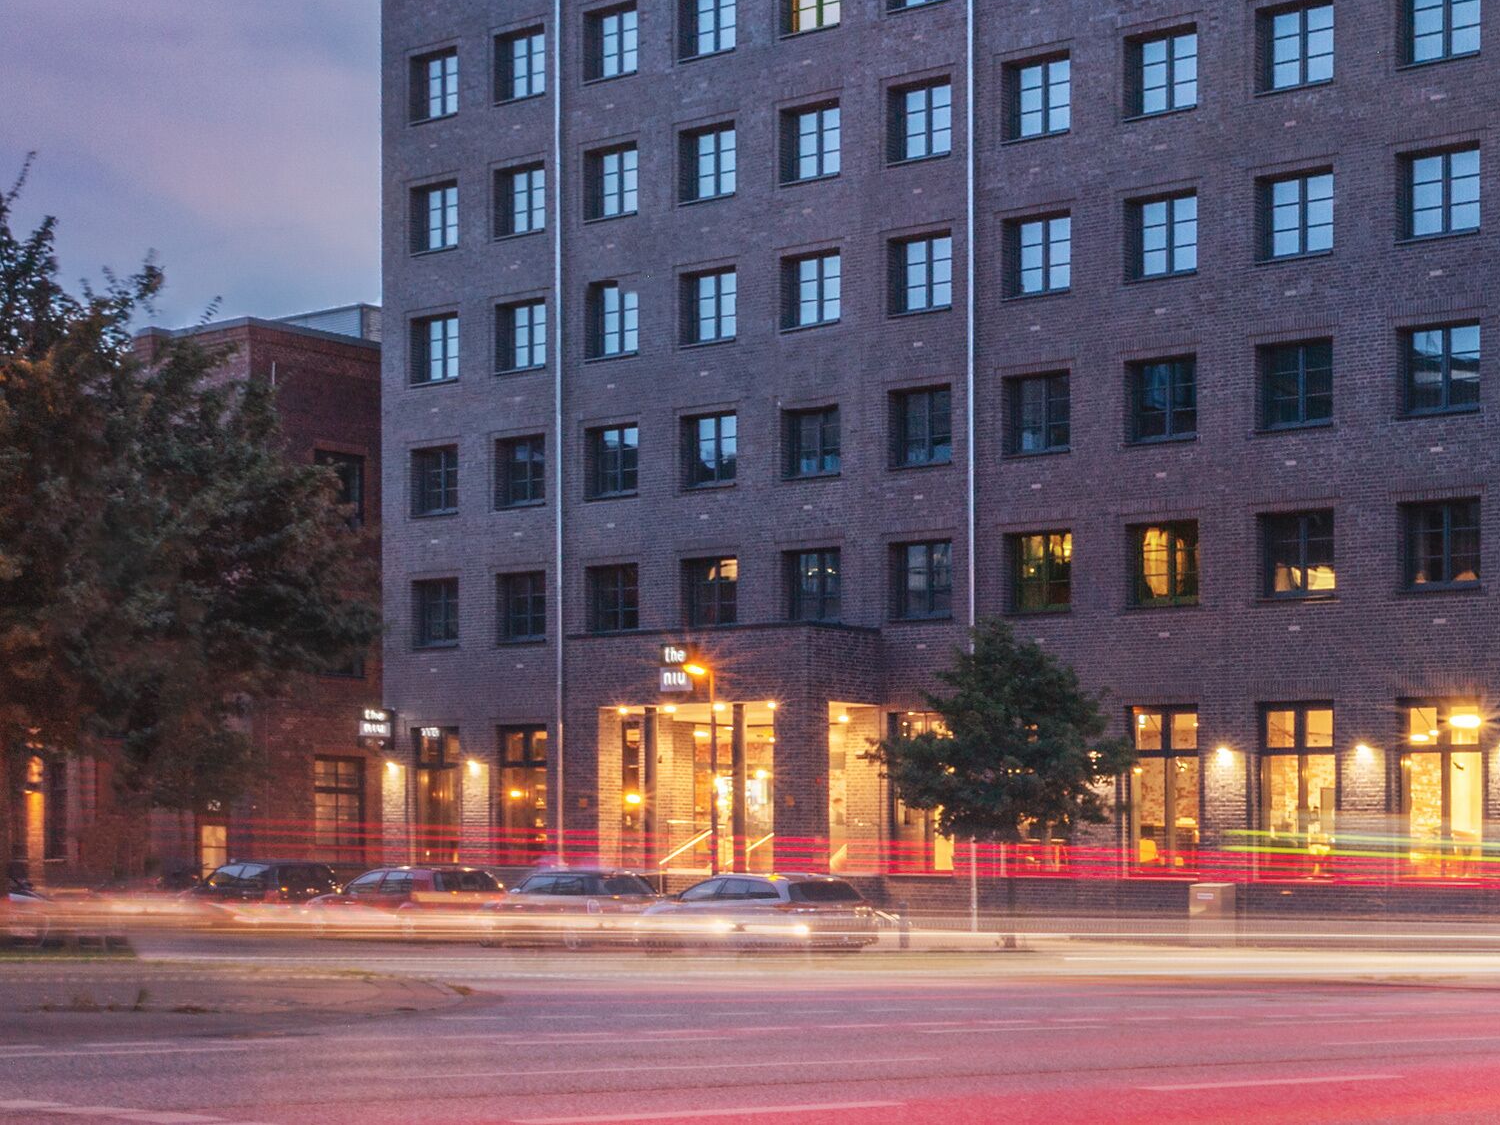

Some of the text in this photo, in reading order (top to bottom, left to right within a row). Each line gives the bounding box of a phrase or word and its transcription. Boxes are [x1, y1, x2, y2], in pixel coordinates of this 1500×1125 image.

[664, 646, 687, 663] the
[663, 672, 687, 686] niu
[364, 709, 386, 721] the
